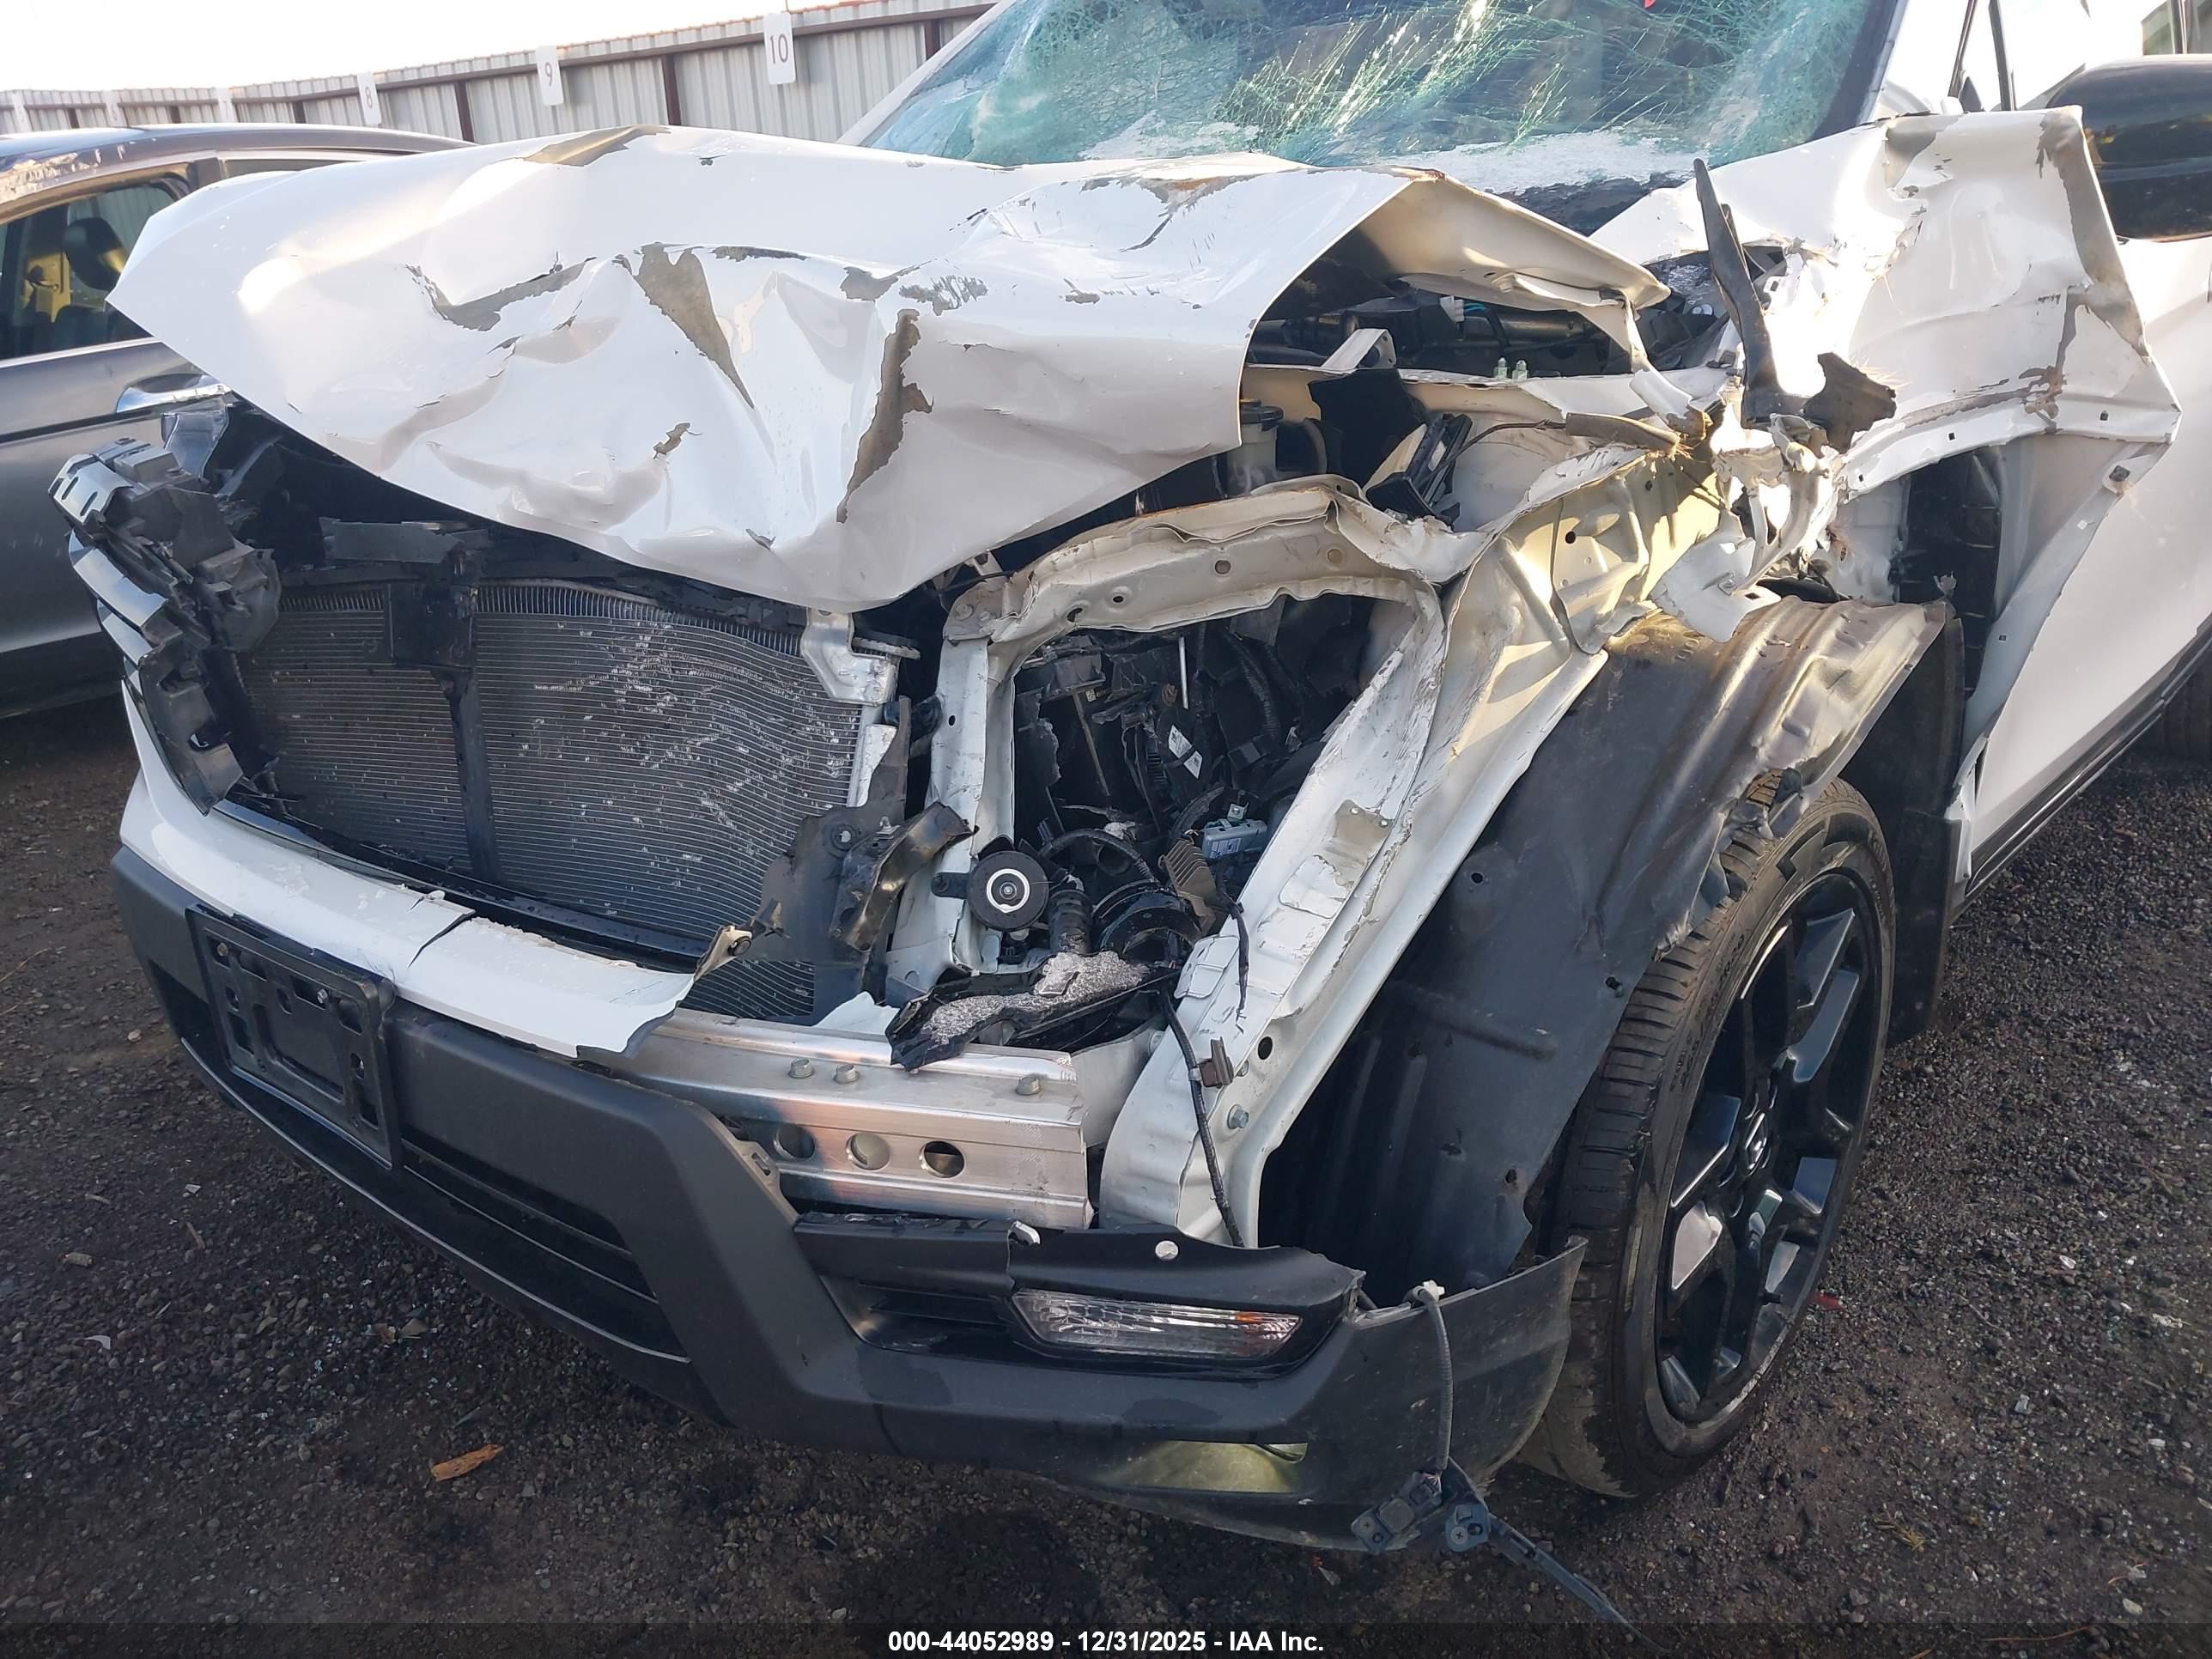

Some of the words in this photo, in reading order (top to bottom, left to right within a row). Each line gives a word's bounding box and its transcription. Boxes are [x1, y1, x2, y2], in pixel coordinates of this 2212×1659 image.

[769, 33, 789, 64] 10
[544, 61, 553, 87] 9
[364, 86, 374, 108] 8
